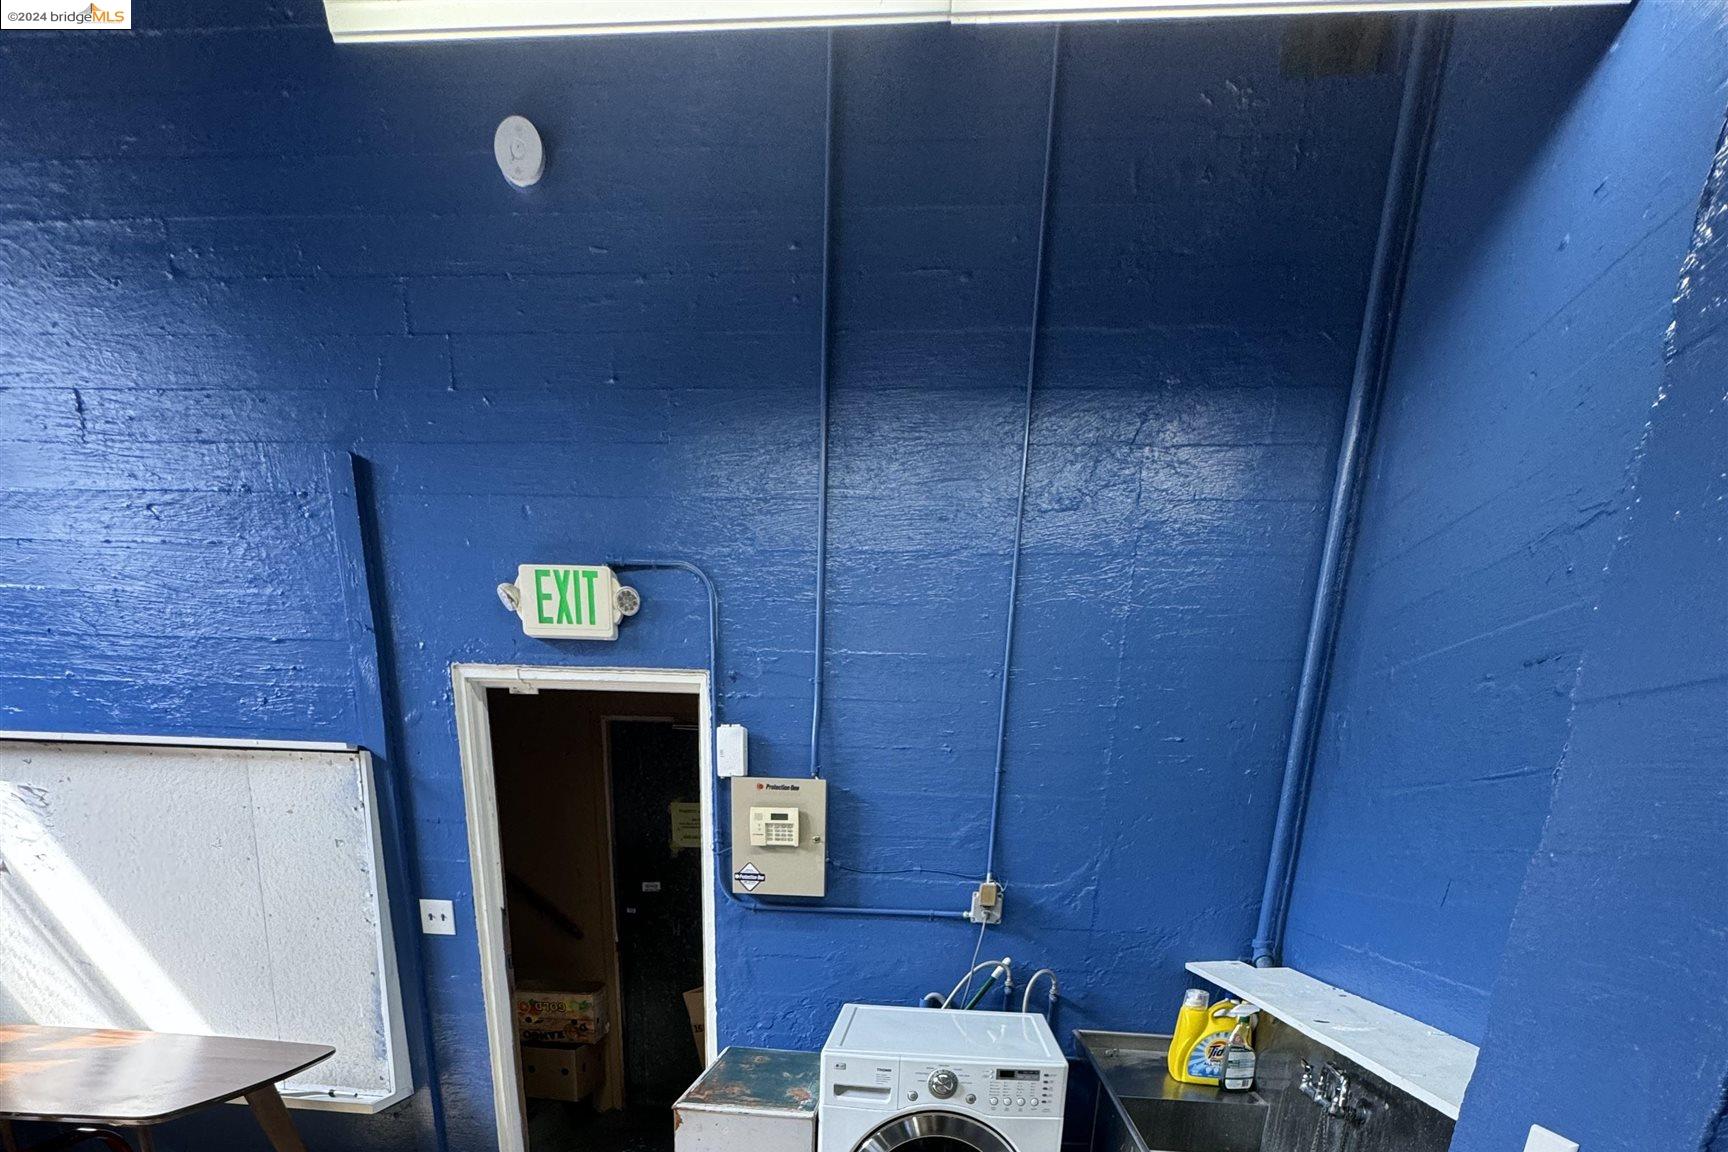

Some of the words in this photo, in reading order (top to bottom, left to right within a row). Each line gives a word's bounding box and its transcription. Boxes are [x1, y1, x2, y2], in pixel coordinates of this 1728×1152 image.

[534, 569, 598, 625] EXIT
[535, 1001, 566, 1013] GOLD
[1208, 1045, 1226, 1059] Tid
